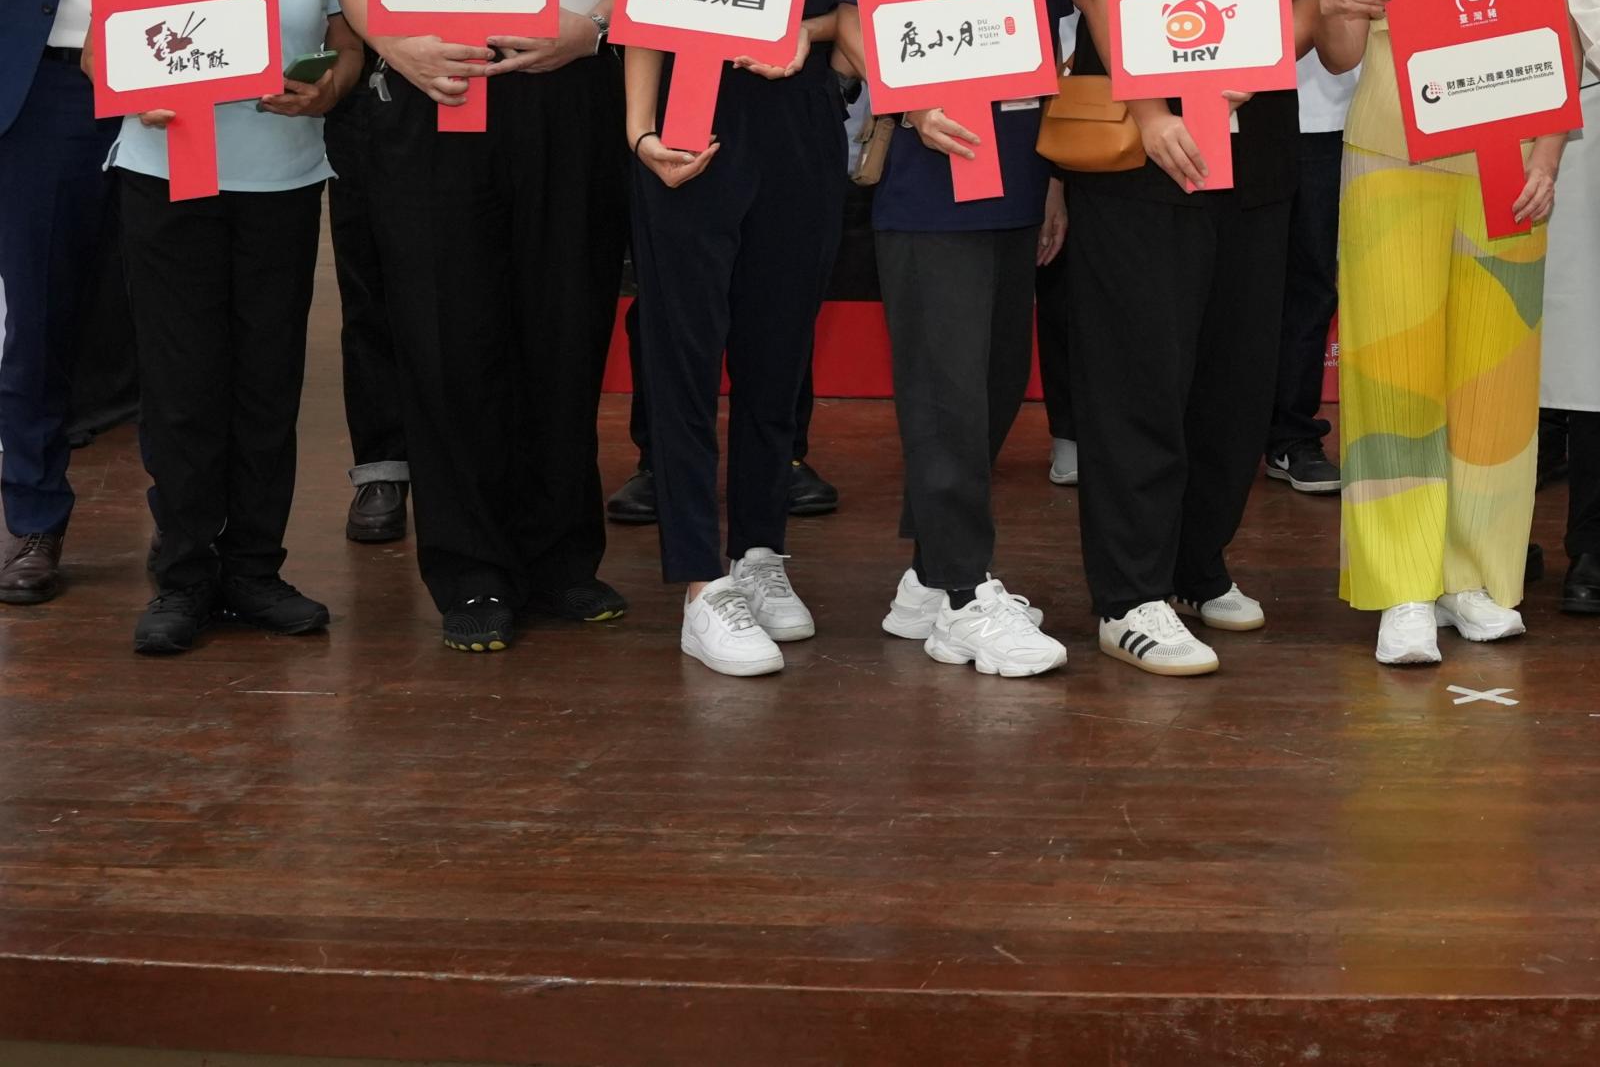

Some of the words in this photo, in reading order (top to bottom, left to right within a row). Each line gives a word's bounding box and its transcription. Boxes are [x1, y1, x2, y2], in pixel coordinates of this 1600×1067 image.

[1446, 61, 1553, 90] 財團法人商業發展研究院
[1448, 87, 1475, 96] Commerce
[1476, 80, 1510, 91] Development
[1510, 76, 1533, 85] Research
[1533, 71, 1555, 80] Institute
